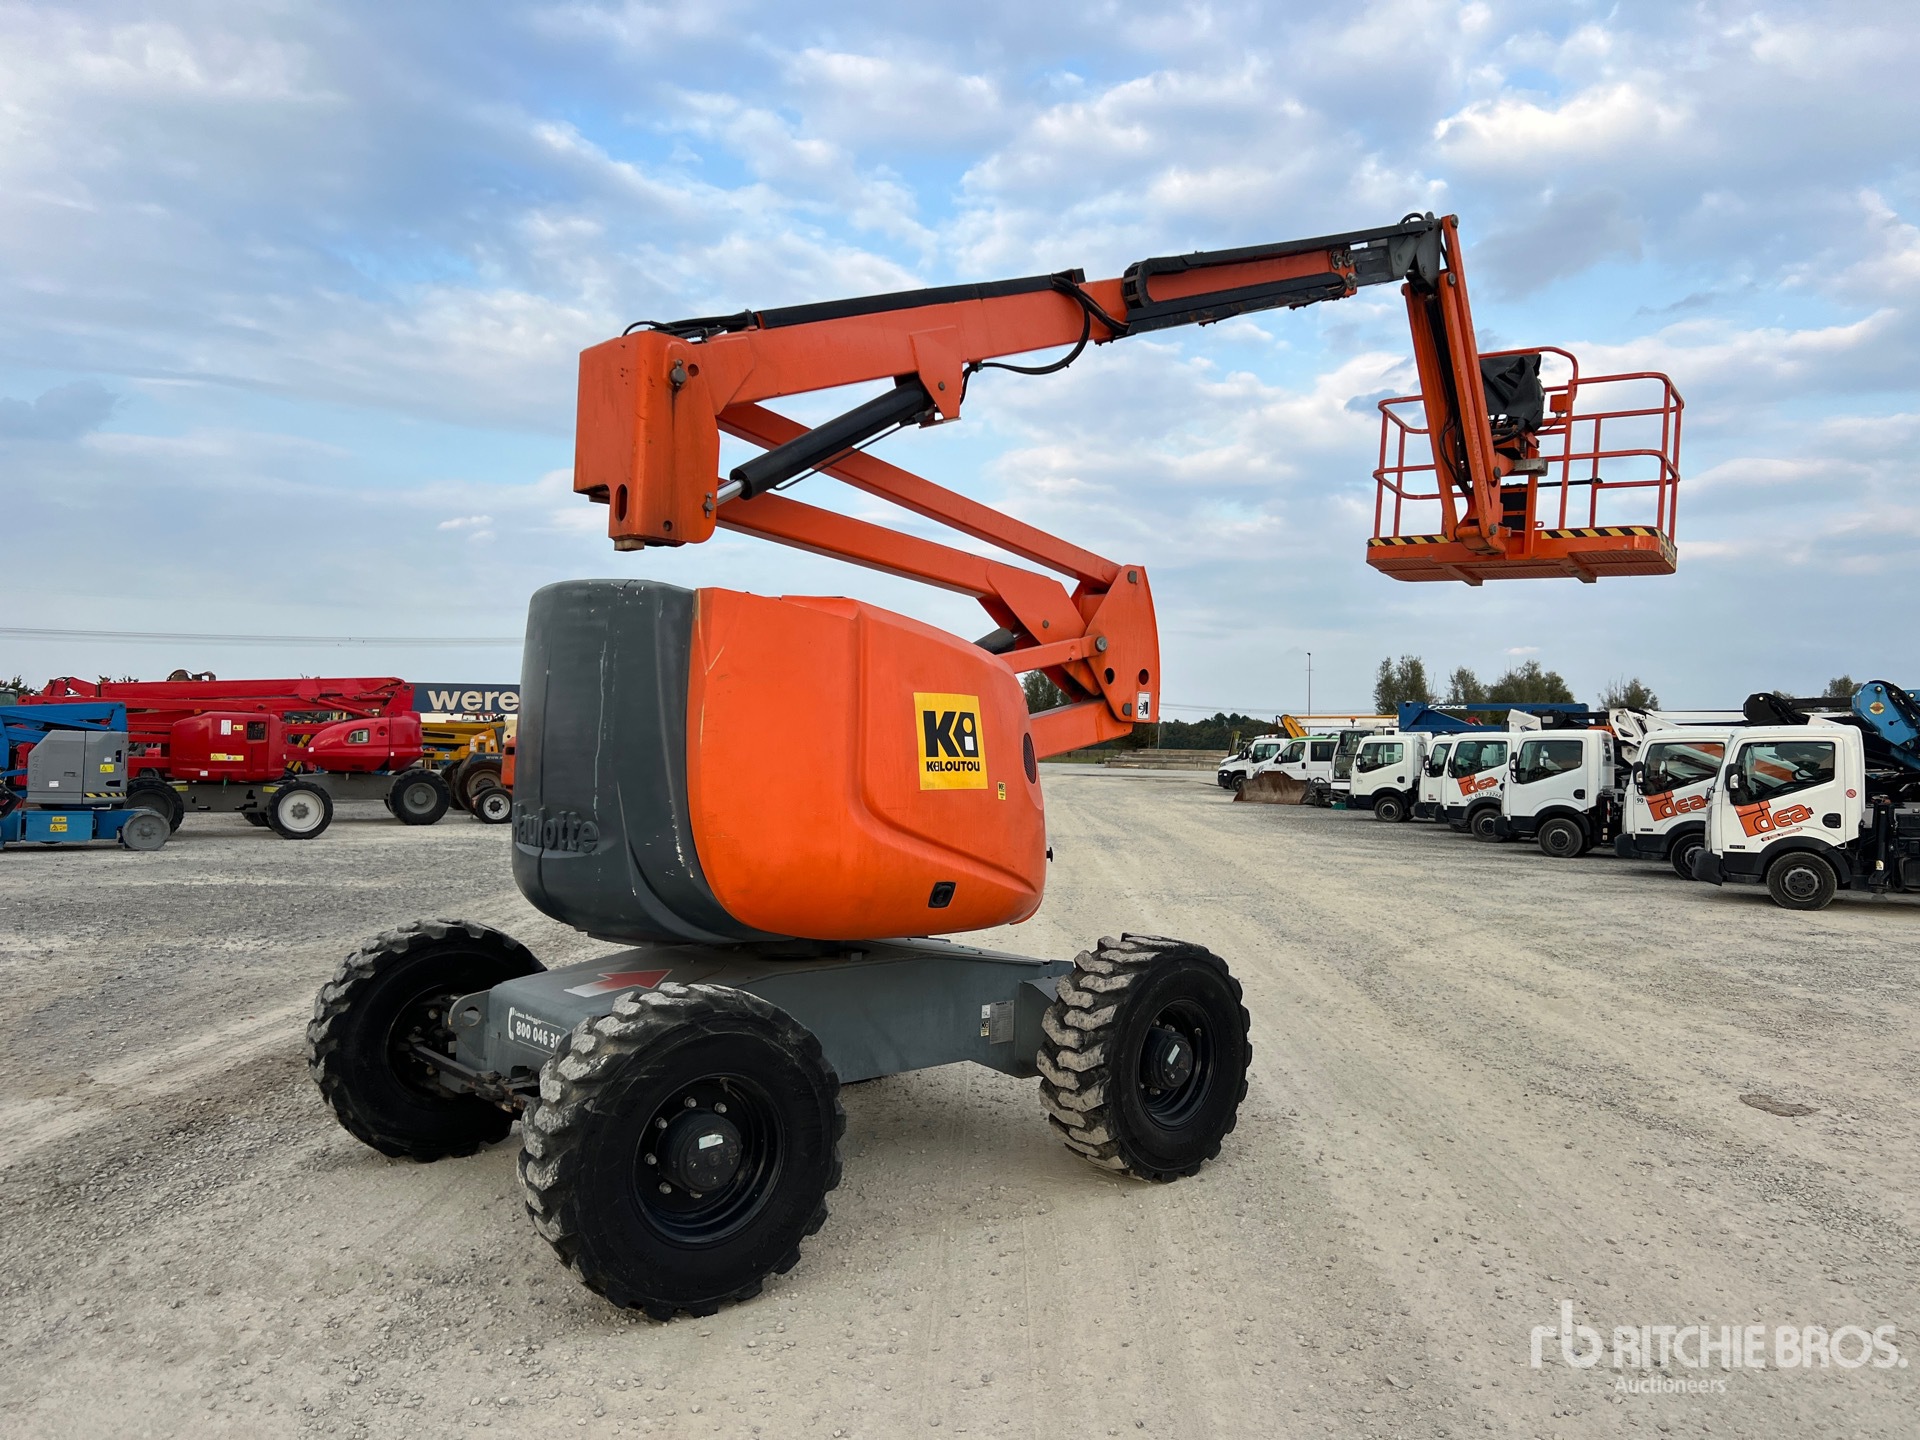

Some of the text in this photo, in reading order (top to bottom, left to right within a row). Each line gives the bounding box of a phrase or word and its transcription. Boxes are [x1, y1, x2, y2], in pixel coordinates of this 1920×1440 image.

[428, 690, 519, 711] were
[516, 1021, 531, 1039] 800
[532, 1027, 548, 1046] 046
